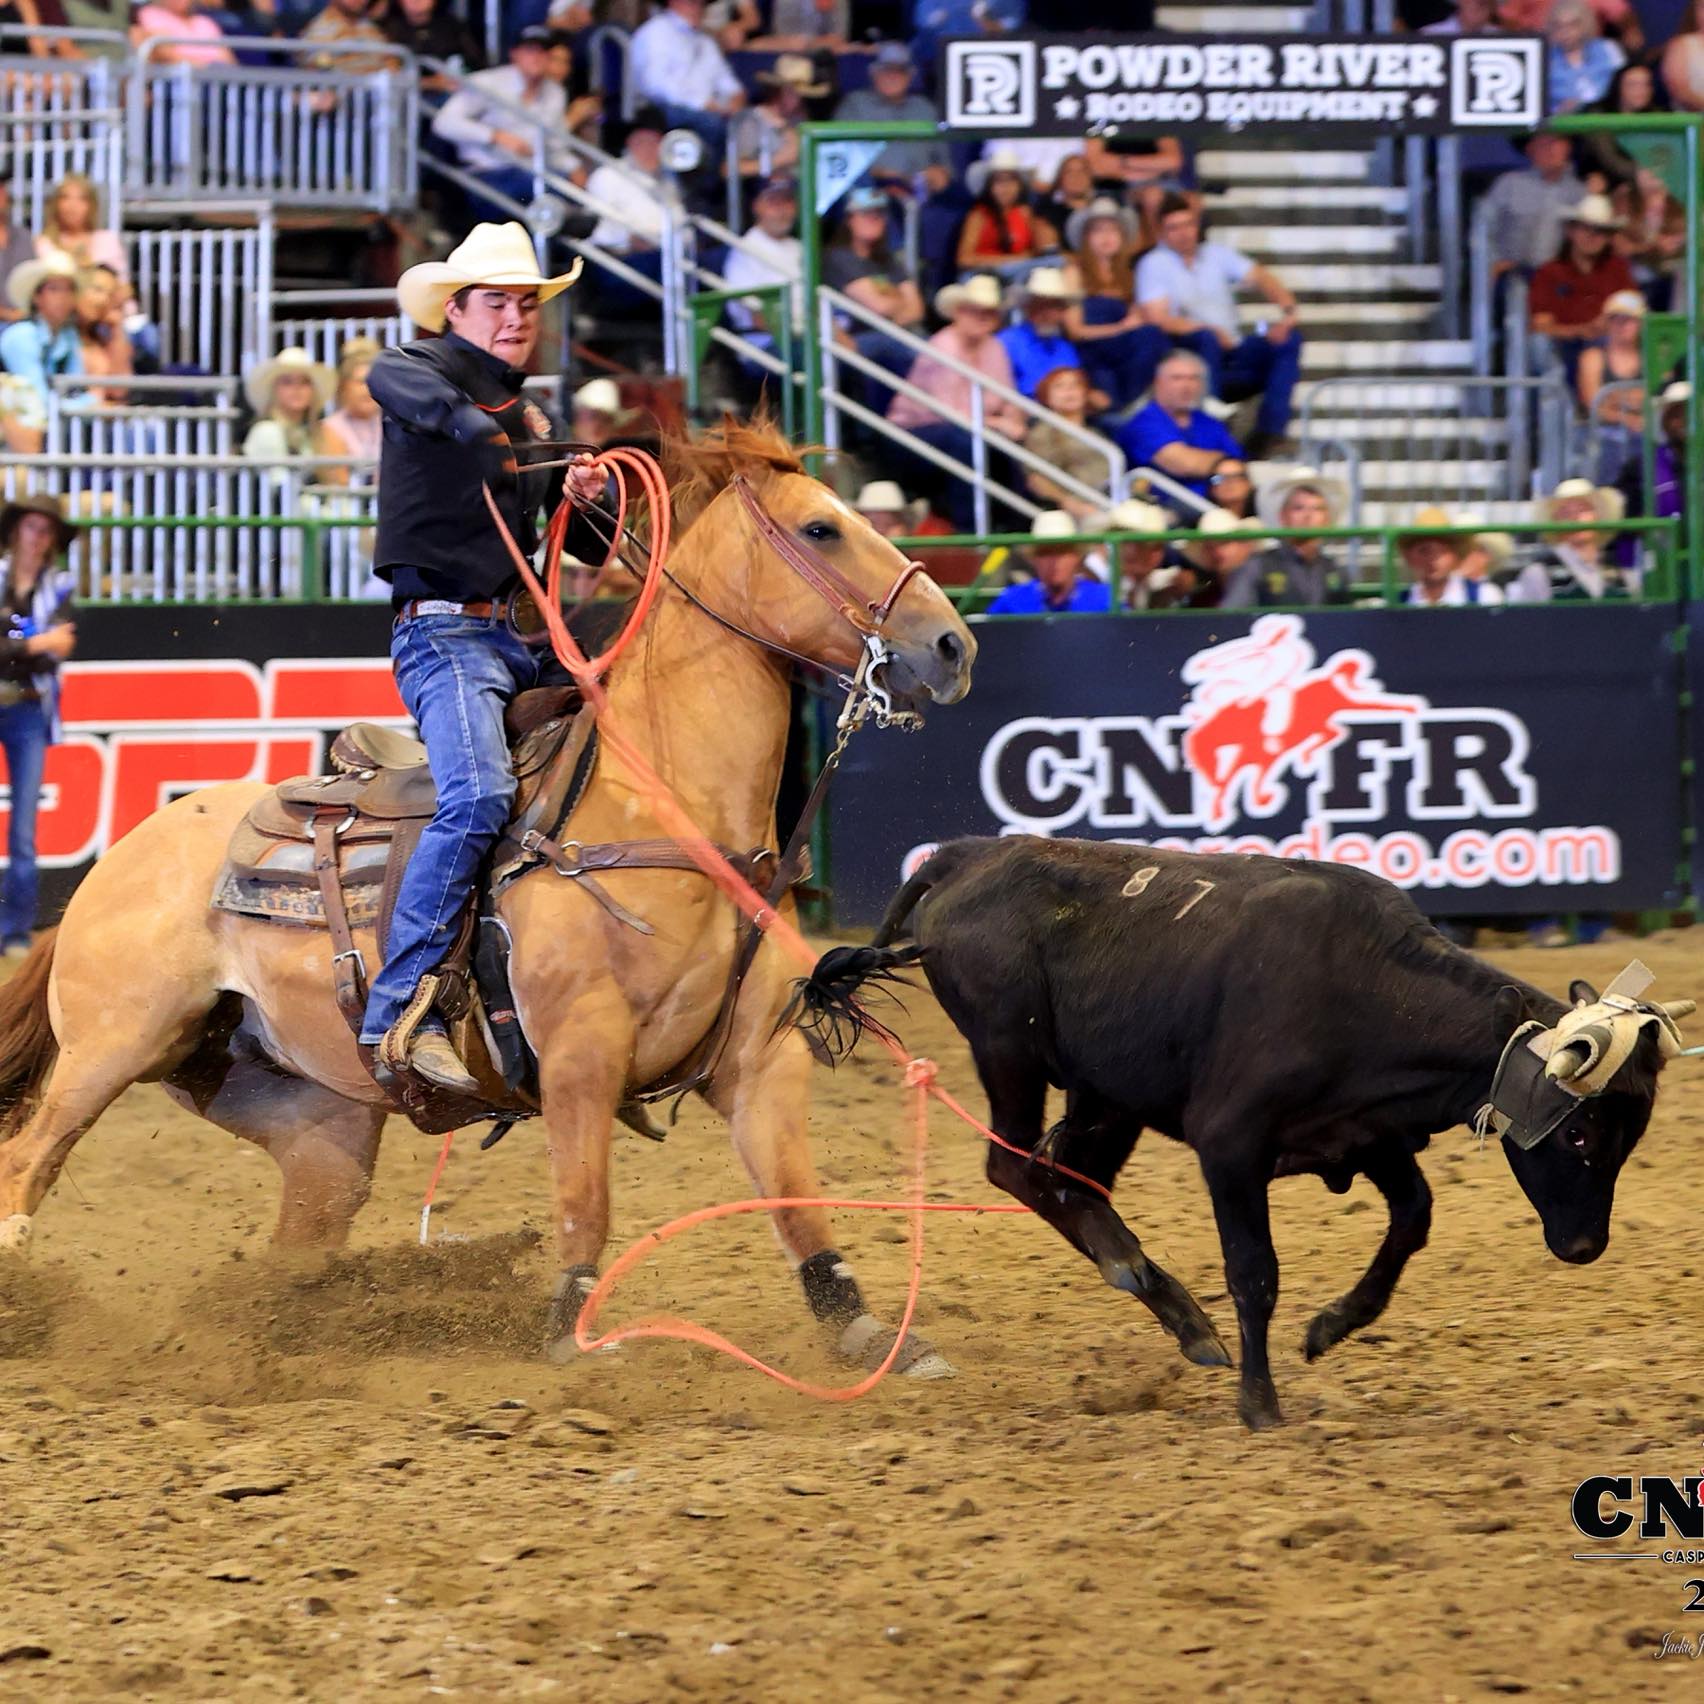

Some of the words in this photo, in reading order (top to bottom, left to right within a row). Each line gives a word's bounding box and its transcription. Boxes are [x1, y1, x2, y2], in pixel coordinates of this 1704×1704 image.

[1041, 44, 1273, 88] POWDER
[1280, 43, 1446, 88] RIVER
[1084, 92, 1202, 122] RODEO
[1206, 91, 1408, 122] EQUIPMENT
